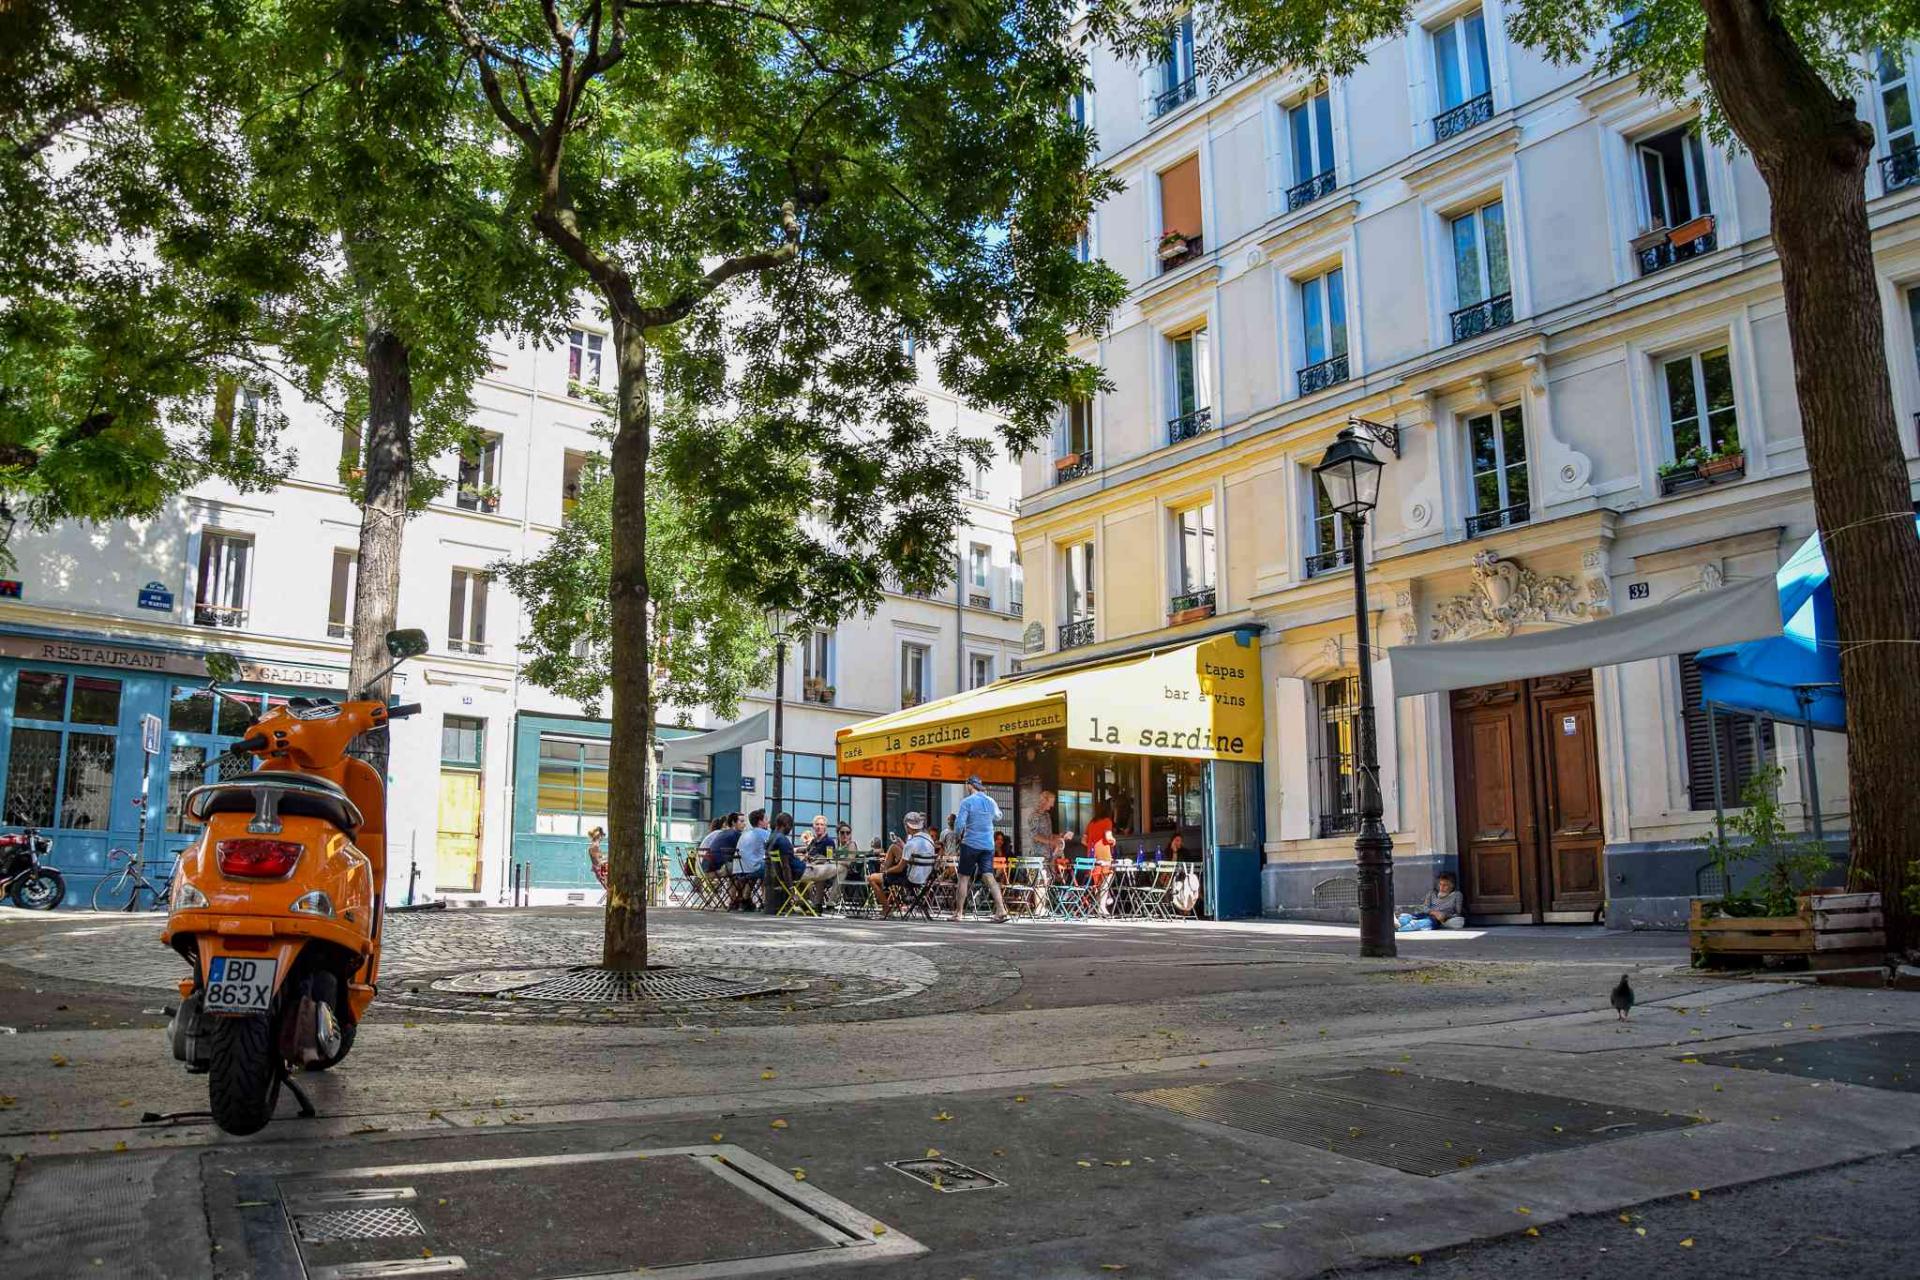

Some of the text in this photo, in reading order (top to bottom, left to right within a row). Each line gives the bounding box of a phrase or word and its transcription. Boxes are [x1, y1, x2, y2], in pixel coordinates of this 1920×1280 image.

[1631, 583, 1648, 599] 32
[42, 644, 166, 669] RESTAURANT
[1205, 661, 1245, 680] tapas
[1164, 685, 1190, 701] bar
[1214, 691, 1246, 707] vins
[844, 713, 1061, 759] café la sardine restaurant
[1089, 717, 1245, 754] la sardine
[226, 961, 257, 982] BD
[208, 983, 270, 1006] 863X
